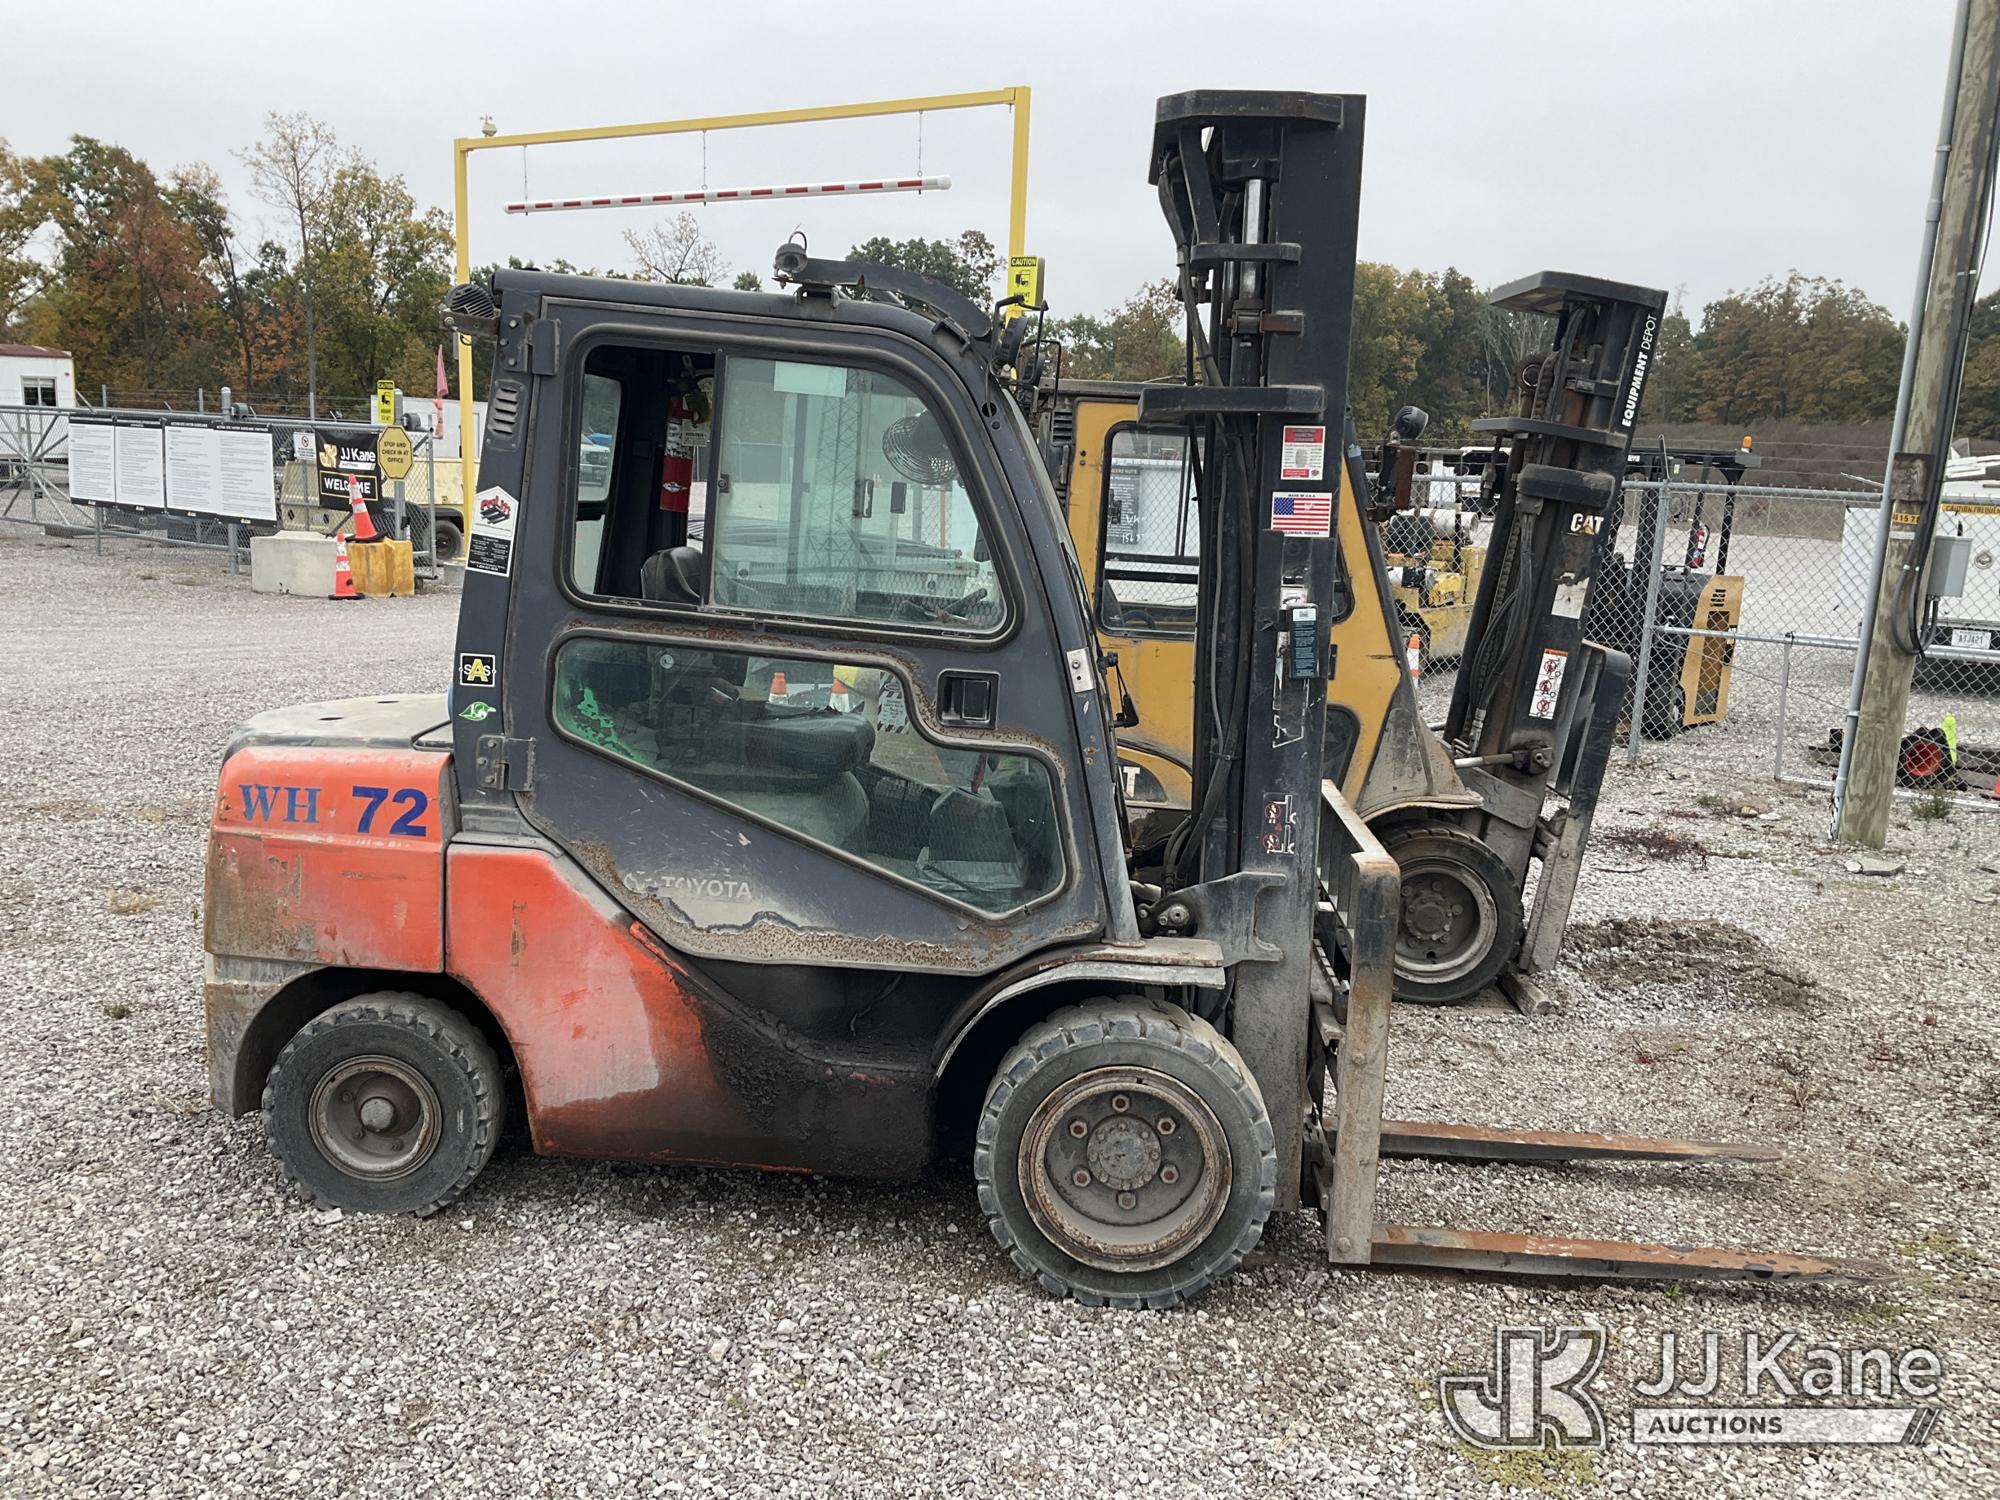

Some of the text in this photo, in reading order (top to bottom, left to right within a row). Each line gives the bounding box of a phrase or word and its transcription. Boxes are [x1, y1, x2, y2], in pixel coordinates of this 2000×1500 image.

[1011, 258, 1036, 266] CAUTION
[1622, 314, 1657, 427] EQUIPMENT DEPOT
[340, 447, 376, 462] JJ Kane
[1570, 513, 1605, 535] CAT
[463, 658, 492, 682] SAS
[239, 784, 429, 836] WH 72
[662, 876, 752, 898] TOYOTA
